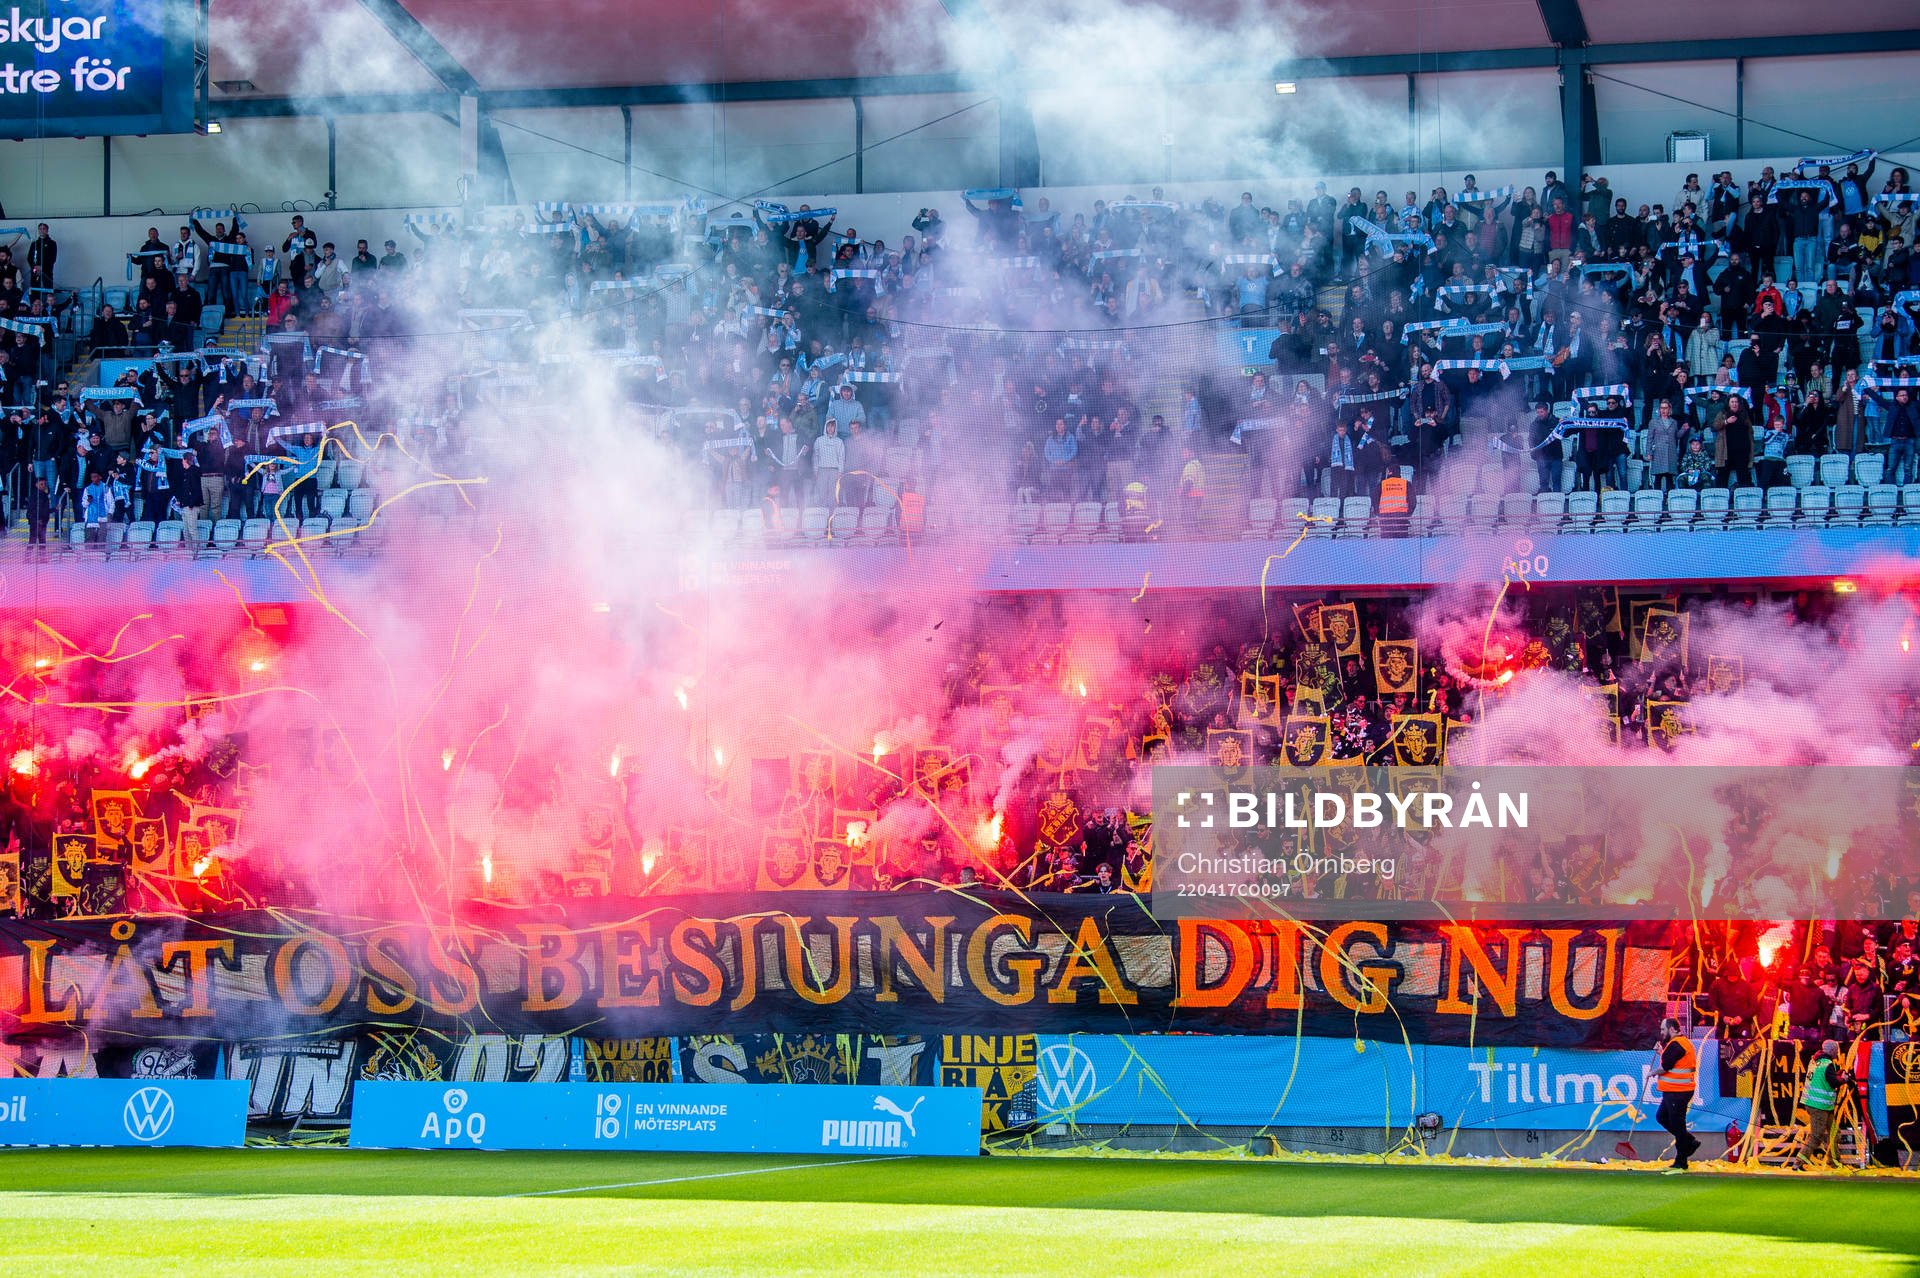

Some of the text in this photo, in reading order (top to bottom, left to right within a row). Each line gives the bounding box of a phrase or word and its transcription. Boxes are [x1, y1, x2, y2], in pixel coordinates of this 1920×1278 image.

[71, 56, 131, 91] för
[21, 914, 1625, 1023] LÅT OSS BESJUNGA DIG NU
[943, 1035, 1035, 1064] LINJE
[635, 1103, 727, 1116] EN VINNANDE
[420, 1111, 486, 1145] ApQ
[634, 1117, 717, 1131] MÖTESPLATS
[1330, 1129, 1344, 1142] 83
[1526, 1130, 1539, 1143] 84
